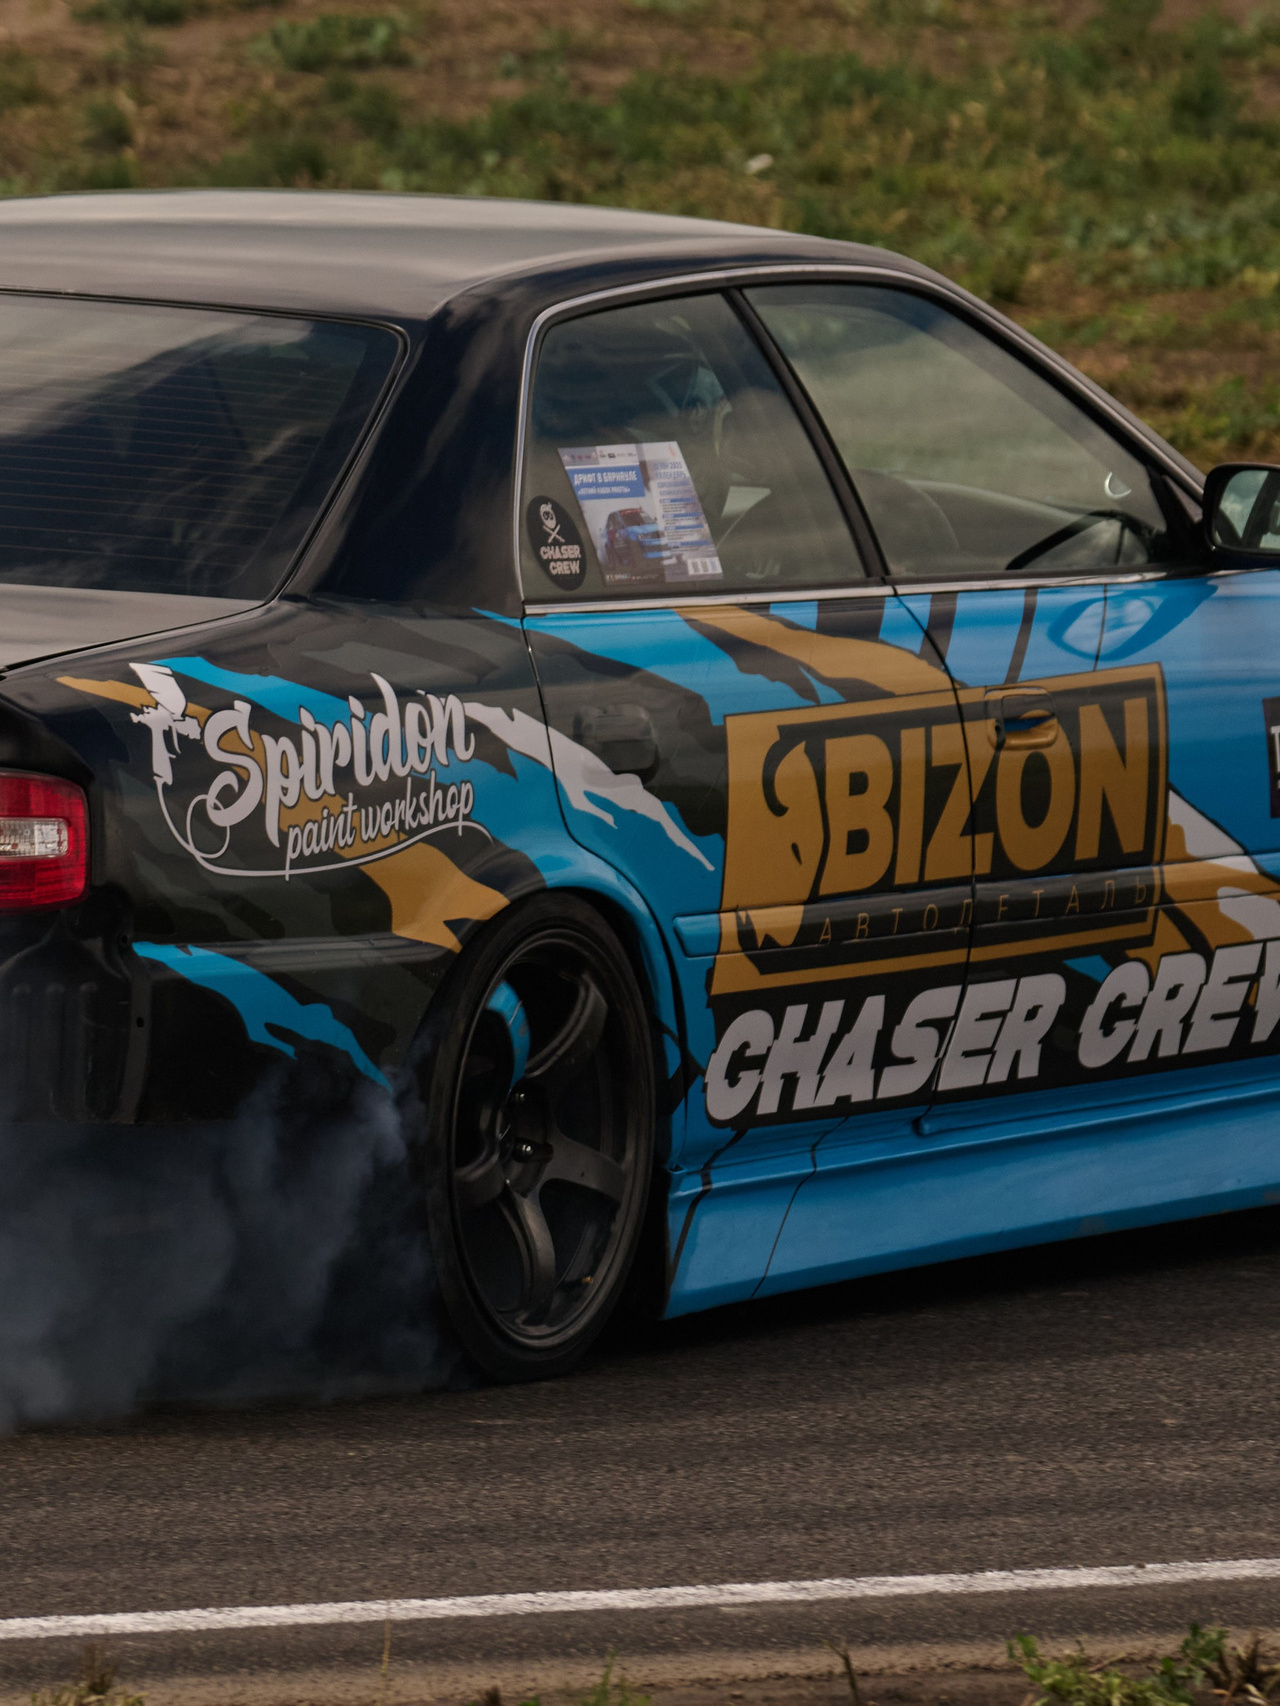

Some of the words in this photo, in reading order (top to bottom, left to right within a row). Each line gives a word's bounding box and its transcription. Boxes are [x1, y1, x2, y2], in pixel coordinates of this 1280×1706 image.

[573, 473, 596, 486] ДРИФТ
[597, 472, 603, 483] В
[603, 470, 638, 482] БАРНАУЛЕ
[540, 544, 582, 560] CHASER
[549, 560, 580, 575] CREW
[204, 672, 475, 848] Spiridon
[819, 697, 1149, 896] BIZON
[284, 792, 358, 881] paint
[361, 769, 475, 837] workshop
[703, 972, 1067, 1121] CHASER
